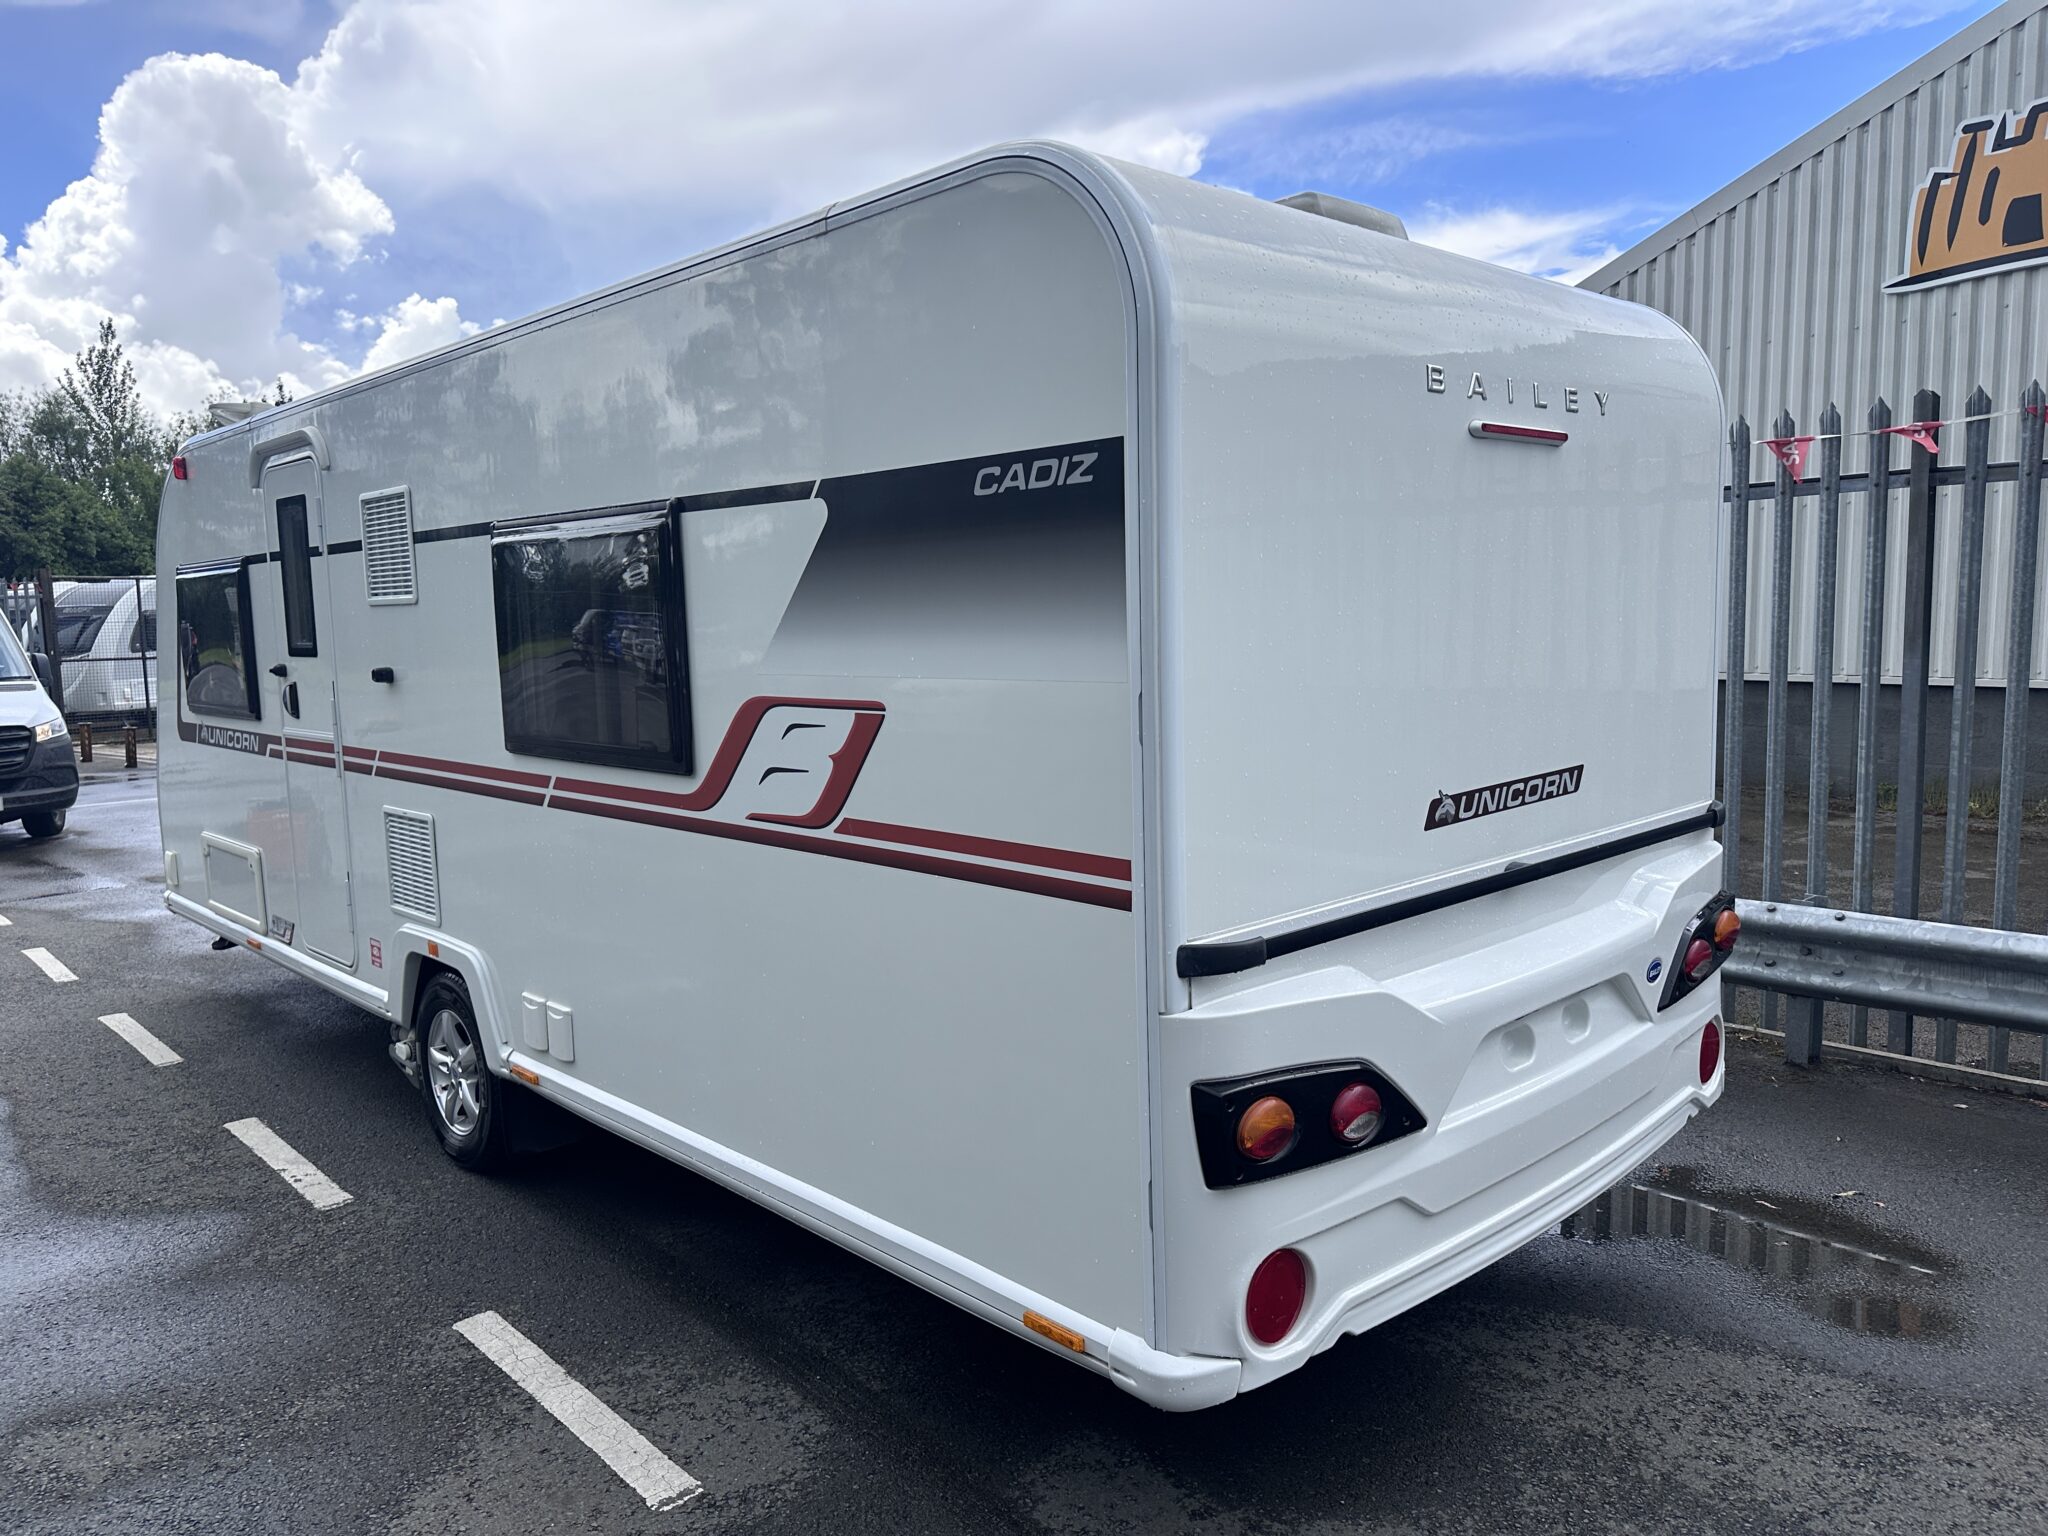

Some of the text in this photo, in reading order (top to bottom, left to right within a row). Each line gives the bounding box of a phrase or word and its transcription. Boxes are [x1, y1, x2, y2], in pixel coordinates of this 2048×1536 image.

[1426, 363, 1609, 416] BAILEY
[973, 452, 1099, 496] CADIZ
[208, 727, 259, 752] UNICORN
[1458, 769, 1578, 819] UNICORN
